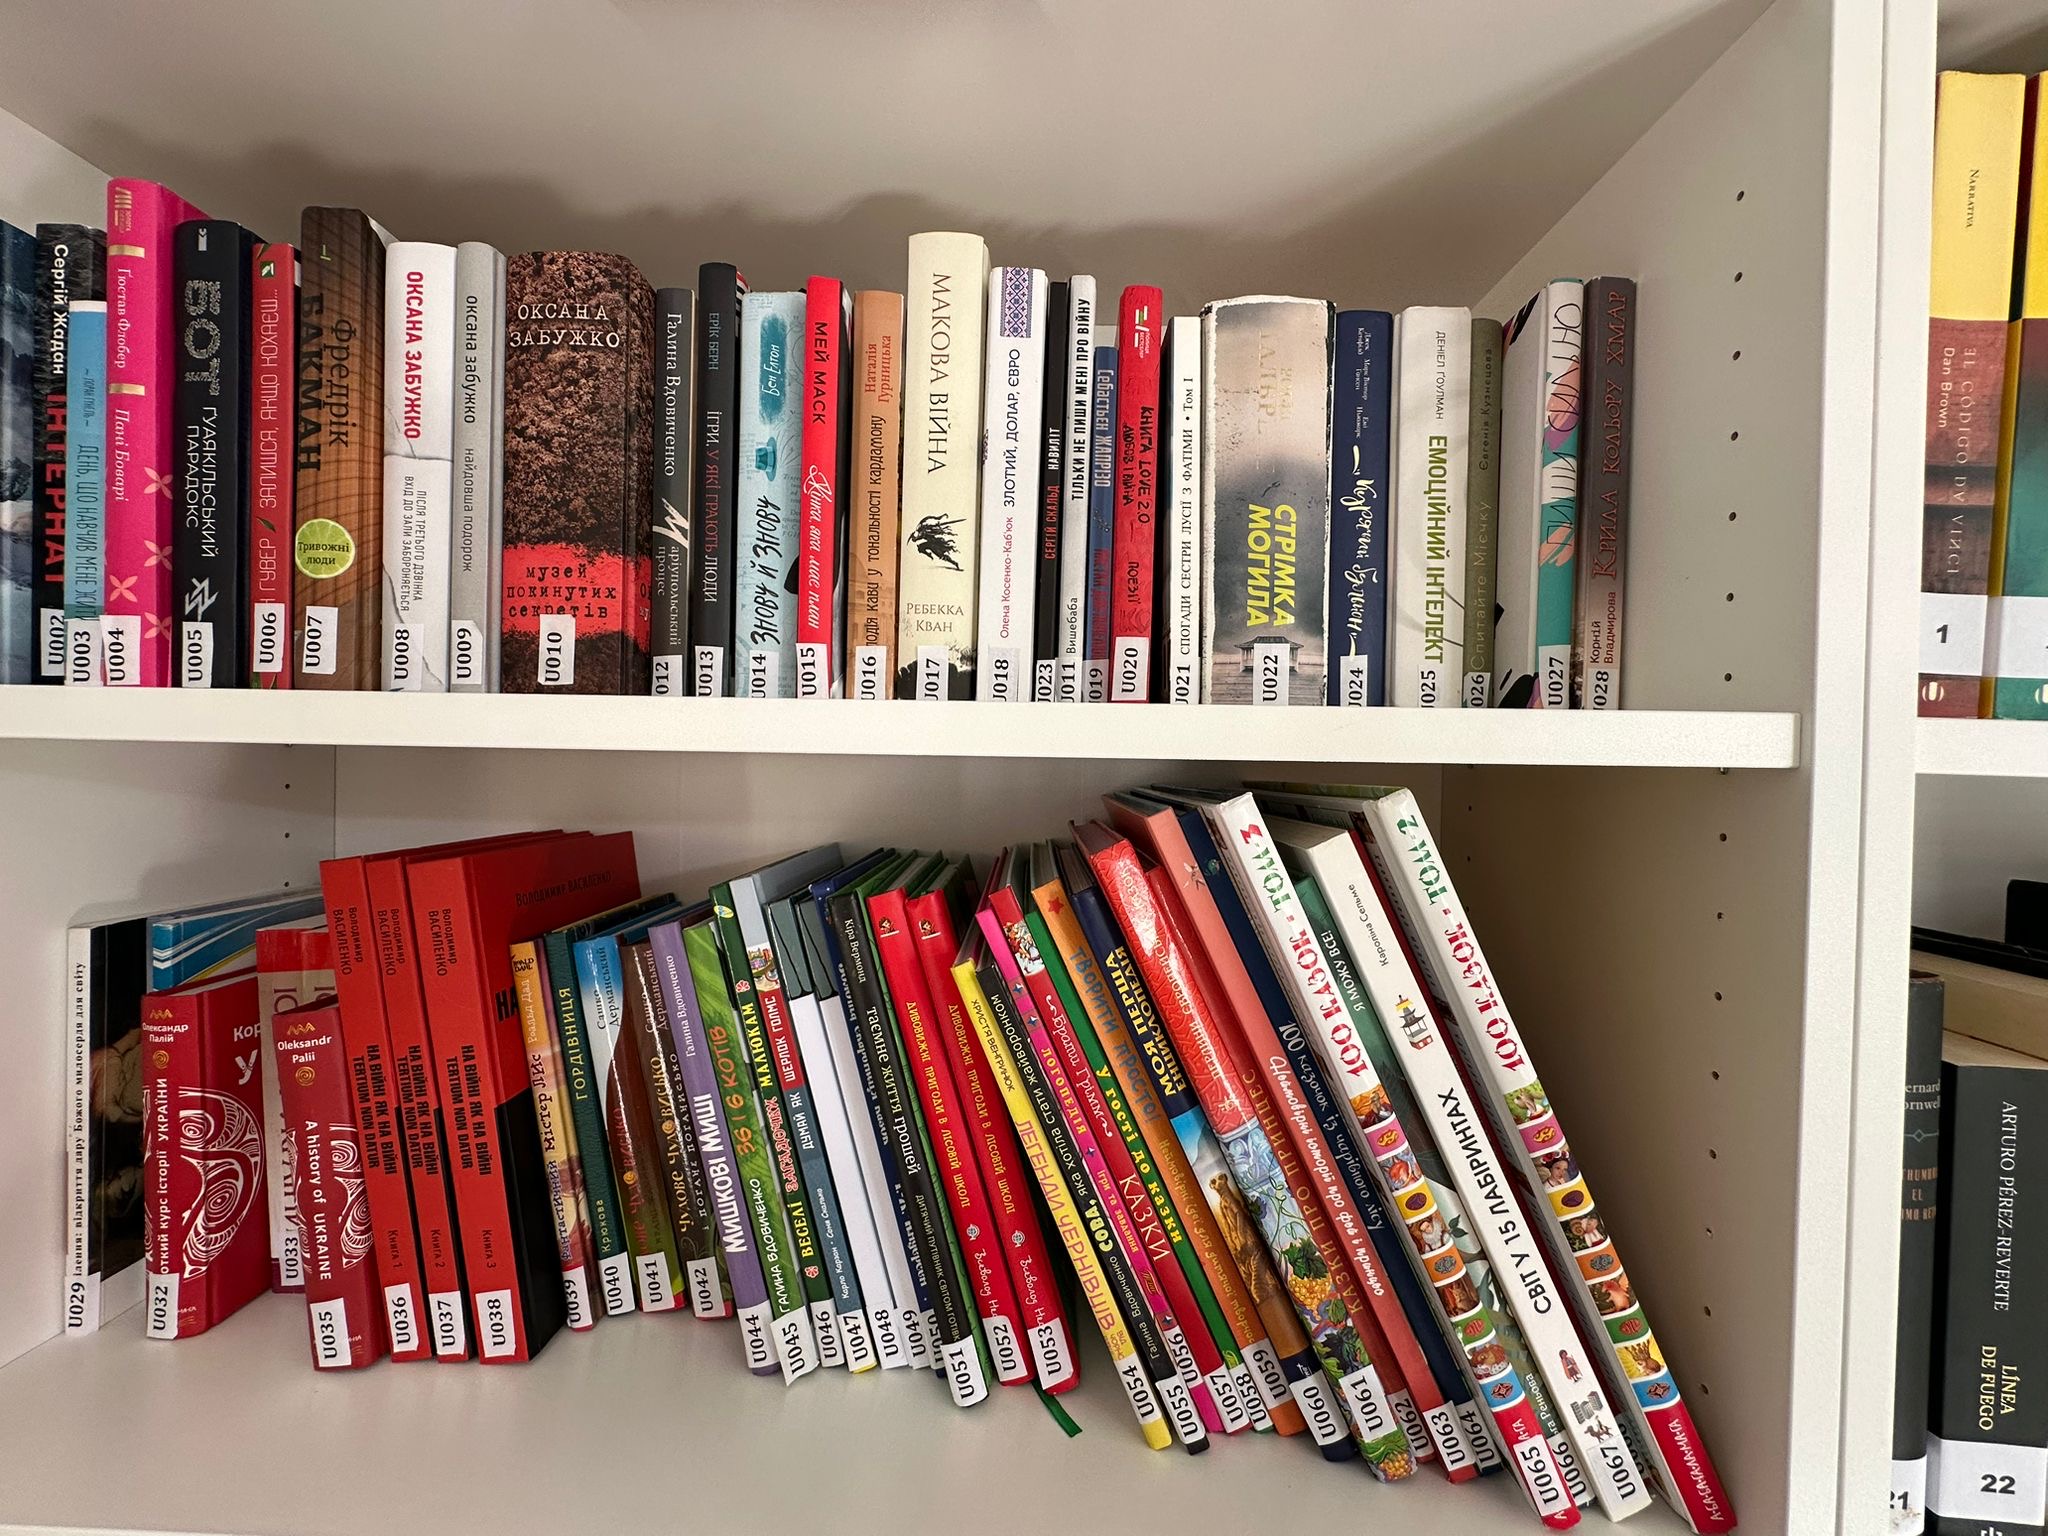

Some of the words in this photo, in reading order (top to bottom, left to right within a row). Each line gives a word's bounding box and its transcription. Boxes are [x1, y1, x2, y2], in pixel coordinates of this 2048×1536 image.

[51, 244, 69, 306] Сергій
[405, 271, 424, 345] ОКСАНА
[465, 295, 478, 351] оксана
[517, 304, 610, 321] ОКСАНА
[929, 272, 952, 385] МАКОВА
[1075, 297, 1090, 335] ВІЙНУ
[51, 308, 70, 375] Жадан
[509, 330, 620, 348] ЗАБУЖКО
[667, 313, 682, 371] Галина
[708, 341, 719, 370] БЕРН
[814, 321, 830, 367] МЕЙ
[1077, 338, 1089, 362] ПРО
[1435, 330, 1446, 368] ДЕНІЕЛ
[1941, 347, 1956, 376] Dan
[298, 294, 325, 472] БАКМАН
[324, 319, 357, 448] Фредрік
[462, 355, 481, 424] забужко
[864, 342, 878, 394] Наталія
[1008, 348, 1021, 387] ЄВРО
[1075, 365, 1088, 395] МЕНІ
[403, 350, 423, 439] ЗАБУЖКО
[812, 371, 828, 425] МАСК
[1005, 392, 1020, 443] ДОЛАР,
[1074, 400, 1087, 435] ПИШИ
[1937, 381, 1954, 428] Brown
[115, 409, 130, 448] Пані
[661, 376, 681, 476] Вдовиченко
[927, 392, 952, 474] ВІЙНА
[1074, 438, 1086, 456] НЕ
[1955, 381, 1975, 464] CÓDIGO
[114, 450, 130, 502] Боварі
[185, 425, 199, 528] ПАРАДОКС
[201, 407, 219, 558] ҐУАЯКІЛЬСЬКИЙ
[463, 448, 478, 512] найдовша
[1003, 446, 1017, 508] ЗЛОТИЙ,
[1423, 435, 1452, 560] ЕМОЦІЙНИЙ
[416, 490, 427, 517] ПІСЛЯ
[297, 541, 350, 555] Тривожні
[305, 556, 336, 567] люди
[414, 518, 426, 562] ТРЕТЬОГО
[462, 515, 474, 572] подорож
[1045, 526, 1057, 560] СЕРГІЙ
[1181, 540, 1192, 589] СЕСТРИ
[1246, 503, 1272, 628] МОГИЛА
[1272, 503, 1298, 627] СТРІМКА
[1946, 514, 1964, 574] VINCI
[413, 563, 424, 602] ДЗВІНКА
[506, 585, 617, 602] покинутих
[525, 562, 588, 582] музей
[655, 546, 667, 596] процес
[260, 612, 277, 665] U006
[999, 604, 1011, 639] Олена
[1065, 597, 1079, 654] Вишебаба
[1180, 594, 1192, 656] СПОГАДИ
[1424, 567, 1446, 664] ІНТЕЛЕКТ
[1603, 591, 1617, 664] Владмирова
[1935, 624, 1949, 644] 1
[73, 630, 91, 683] U003
[108, 627, 125, 683] U004
[187, 628, 203, 683] U005
[305, 616, 323, 669] U007
[394, 628, 410, 680] U008
[456, 627, 472, 679] U009
[544, 631, 563, 683] U010
[1589, 620, 1601, 664] Корній
[801, 646, 817, 698] U015
[1121, 647, 1139, 694] U020
[1262, 654, 1279, 703] U022
[1548, 655, 1565, 707] U027
[332, 908, 353, 976] ВАСИЛЕНКО
[377, 909, 397, 977] ВАСИЛЕНКО
[428, 910, 448, 977] ВАСИЛЕНКО
[666, 955, 688, 1018] Вдовиченко
[1104, 950, 1150, 1037] ПЕРША
[142, 1022, 190, 1034] Олександр
[149, 1033, 175, 1044] Палій
[682, 1017, 697, 1057] Галина
[764, 995, 785, 1033] ГОЛМС
[865, 1005, 890, 1064] таємне
[989, 993, 1039, 1086] жайворонком
[1114, 944, 1187, 1093] ЕНЦИКЛОПЕДІЯ
[277, 1035, 333, 1052] Oleksandr
[292, 1052, 316, 1065] Palii
[461, 1044, 475, 1059] НА
[559, 987, 588, 1102] ГОРДІВНИЦЯ
[741, 1001, 775, 1088] МАЛЮКАМ
[774, 1034, 798, 1083] ШЕРЛОК
[1142, 1038, 1178, 1097] МОЯ
[464, 1061, 482, 1099] ВІЙНІ
[788, 1090, 803, 1106] ЯК
[880, 1063, 904, 1119] життя
[1041, 1047, 1087, 1135] ЛОГОПЕДІЯ
[304, 1120, 317, 1131] A
[377, 1121, 390, 1138] НА
[455, 1105, 468, 1131] NON
[472, 1121, 487, 1138] НА
[793, 1107, 816, 1152] ДУМАЙ
[1240, 1068, 1301, 1178] ПРИНЦЕС
[2000, 1100, 2018, 1172] ARTURO
[305, 1134, 322, 1185] history
[459, 1133, 473, 1169] DATUR
[475, 1140, 493, 1176] ВІЙНІ
[763, 1096, 799, 1194] ЗАГАДОЧКИ
[890, 1116, 923, 1177] грошей
[1049, 1127, 1079, 1170] хотіла
[1436, 1086, 1512, 1217] ЛАБІРИНТАХ
[312, 1188, 327, 1204] of
[1070, 1171, 1089, 1196] яка
[1294, 1183, 1324, 1232] ПРО
[749, 1177, 779, 1263] ВДОВИЧЕНКО
[786, 1199, 815, 1258] ВЕСЕЛІ
[1016, 1120, 1066, 1212] ЛЕГЕНДИ
[1056, 1212, 1117, 1332] ЧЕРНІВЦІВ
[1083, 1199, 1115, 1253] СОВА,
[1118, 1172, 1172, 1262] КАЗКИ
[1498, 1219, 1522, 1247] 15
[284, 1237, 300, 1279] U033
[312, 1213, 332, 1281] UKRAINE
[1993, 1176, 2018, 1312] PÉREZ-REVERTE
[603, 1265, 622, 1312] U040
[643, 1260, 664, 1305] U041
[693, 1267, 714, 1314] U042
[1109, 1255, 1143, 1319] Вдовиченко
[1318, 1239, 1365, 1316] КАЗКИ
[1519, 1268, 1553, 1316] СВІТ
[68, 1282, 86, 1328] U029
[153, 1284, 169, 1331] U032
[391, 1296, 411, 1345] U036
[437, 1299, 456, 1348] U037
[487, 1298, 507, 1347] U038
[318, 1311, 337, 1361] U035
[747, 1313, 768, 1363] U044
[781, 1321, 807, 1376] U045
[819, 1309, 838, 1360] U046
[874, 1307, 900, 1359] U048
[991, 1323, 1018, 1373] U052
[1138, 1321, 1161, 1361] Галина
[1981, 1345, 1997, 1369] DE
[950, 1347, 975, 1400] U051
[1121, 1364, 1156, 1418] U054
[1252, 1348, 1288, 1400] U059
[2000, 1364, 2021, 1416] LÍNEA
[1165, 1384, 1199, 1439] U055
[1301, 1384, 1338, 1440] U060
[1349, 1375, 1385, 1433] U061
[1978, 1372, 1996, 1431] FUEGO
[1431, 1410, 1467, 1467] U063
[1519, 1446, 1561, 1506] U065
[1600, 1444, 1637, 1501] U067
[1980, 1473, 2017, 1496] 22
